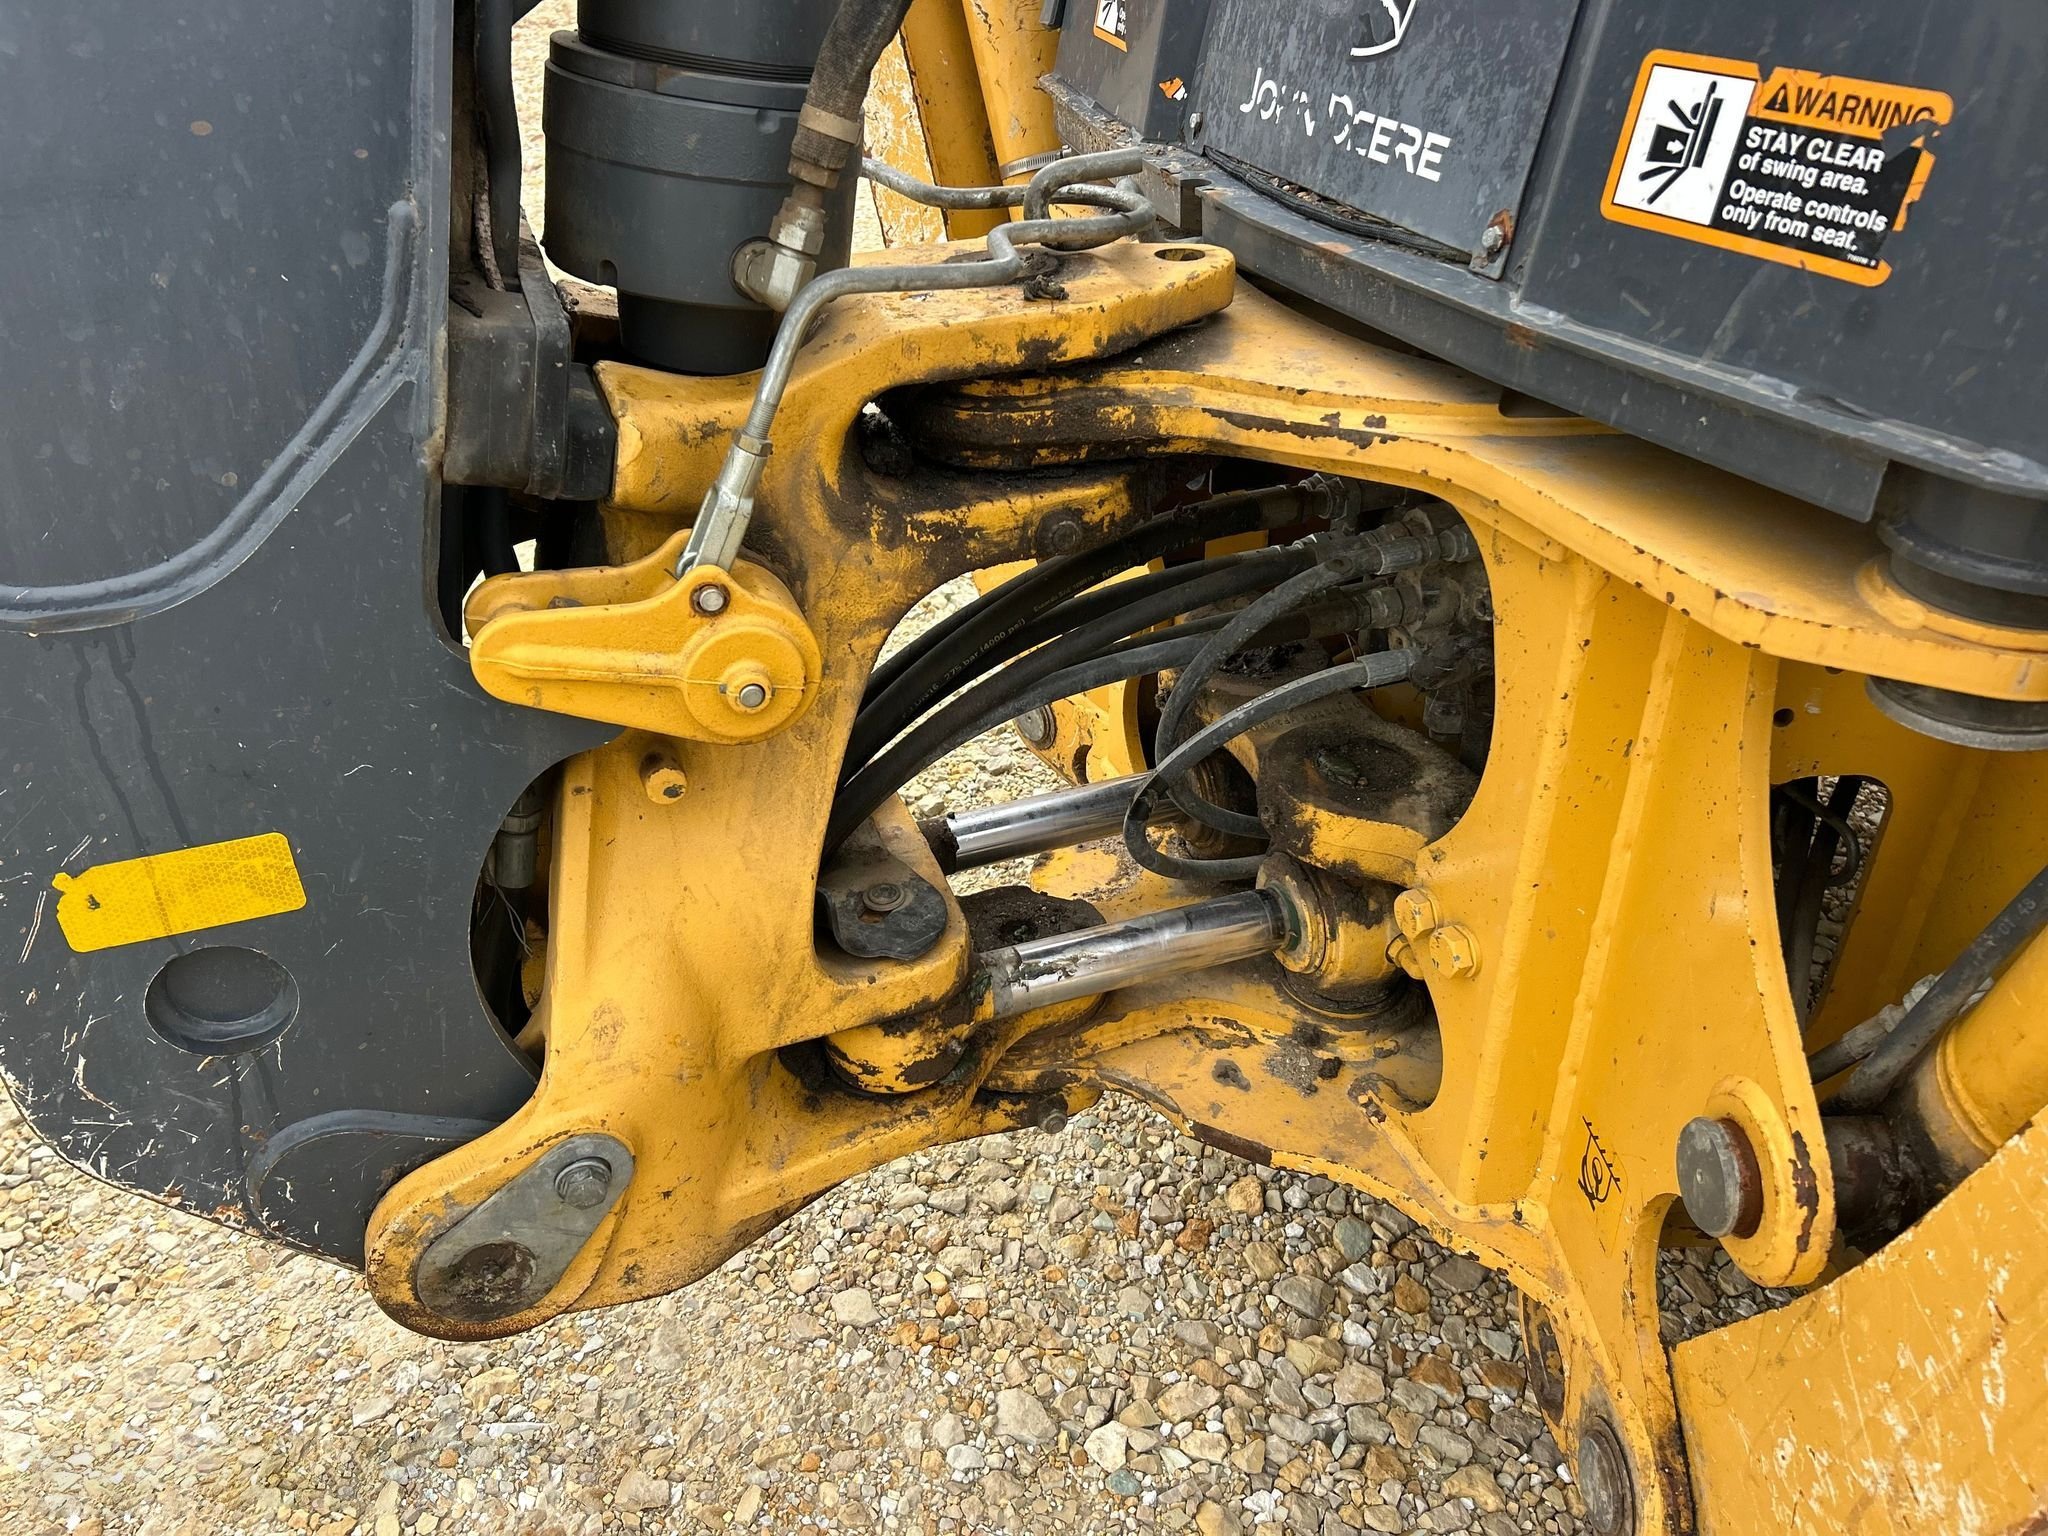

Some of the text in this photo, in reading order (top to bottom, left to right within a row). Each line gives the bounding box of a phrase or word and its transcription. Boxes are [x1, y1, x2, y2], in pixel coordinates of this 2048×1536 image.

[1239, 67, 1316, 137] JON
[1738, 151, 1869, 196] of swing area.
[1745, 126, 1886, 173] STAY CLEAR
[1721, 204, 1859, 252] only from seat.
[1729, 179, 1889, 233] Operate controls
[943, 663, 961, 681] 275
[962, 653, 980, 668] bar
[979, 631, 1006, 654] (4000
